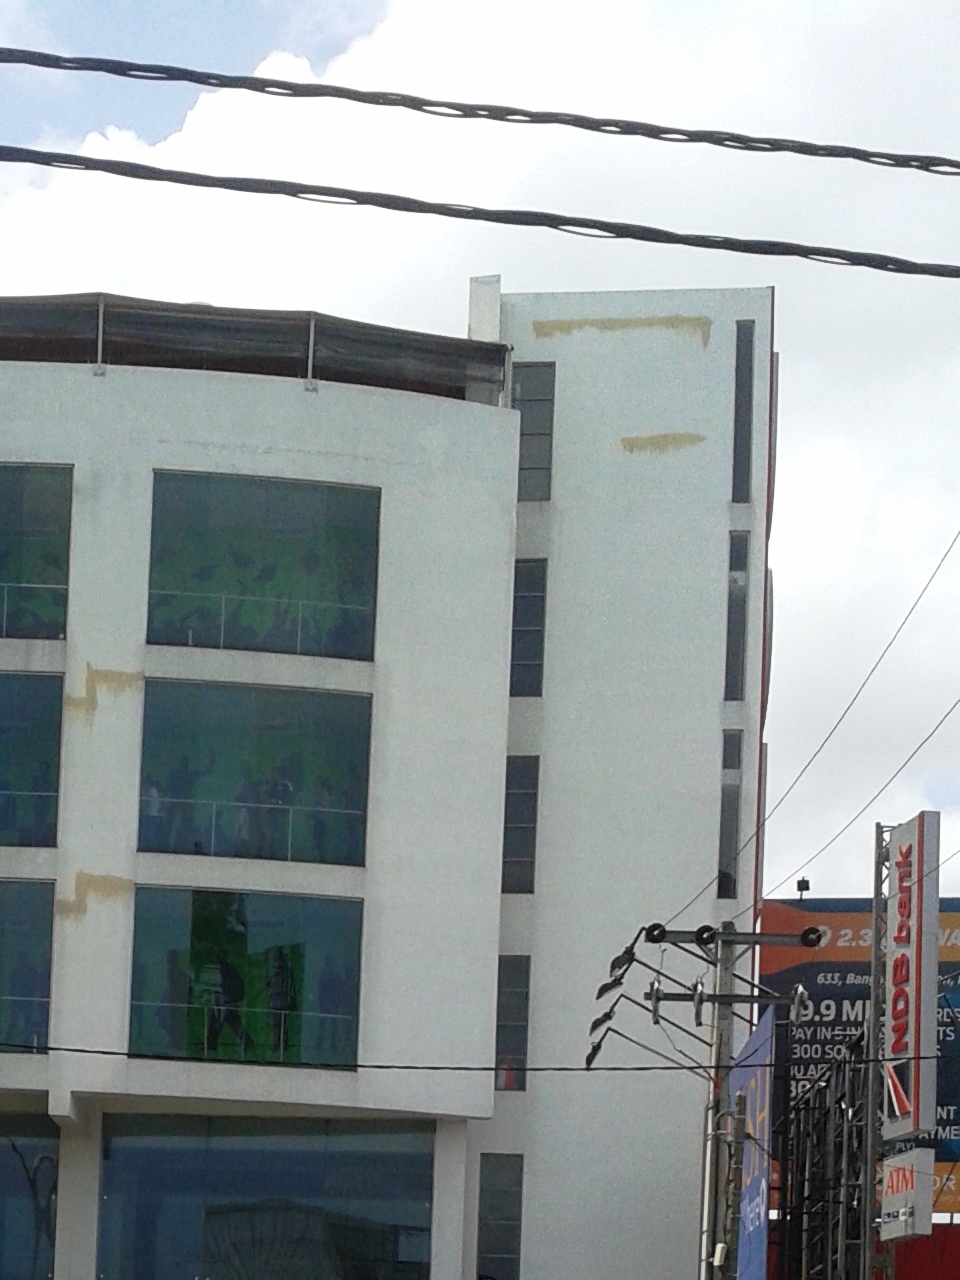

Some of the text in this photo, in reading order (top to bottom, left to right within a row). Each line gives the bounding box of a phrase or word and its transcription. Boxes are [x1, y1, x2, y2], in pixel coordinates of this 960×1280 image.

[891, 843, 913, 1054] bank NDB
[884, 1163, 915, 1197] ATM
